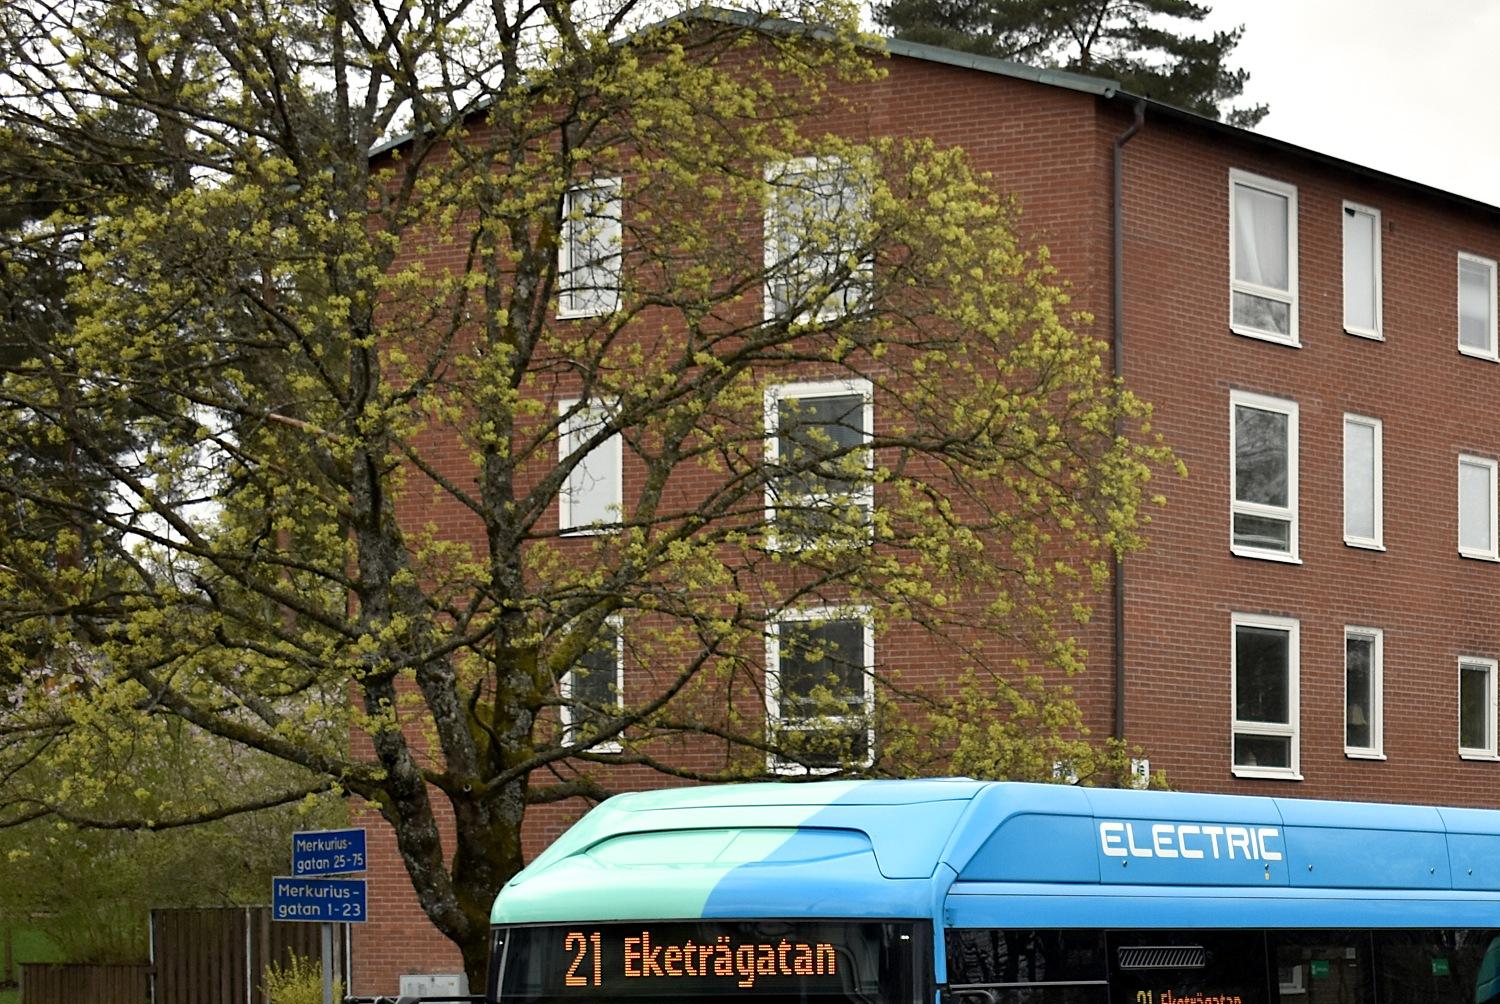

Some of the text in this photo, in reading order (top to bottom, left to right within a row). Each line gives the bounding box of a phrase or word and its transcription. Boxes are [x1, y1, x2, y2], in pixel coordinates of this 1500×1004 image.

[296, 837, 352, 853] Merkurius-
[1099, 821, 1283, 861] ELECTRIC
[296, 856, 330, 874] gatan
[278, 884, 360, 899] Merkurius-
[278, 903, 361, 918] gatan 1-23
[564, 931, 837, 988] 21 Eketrägatan
